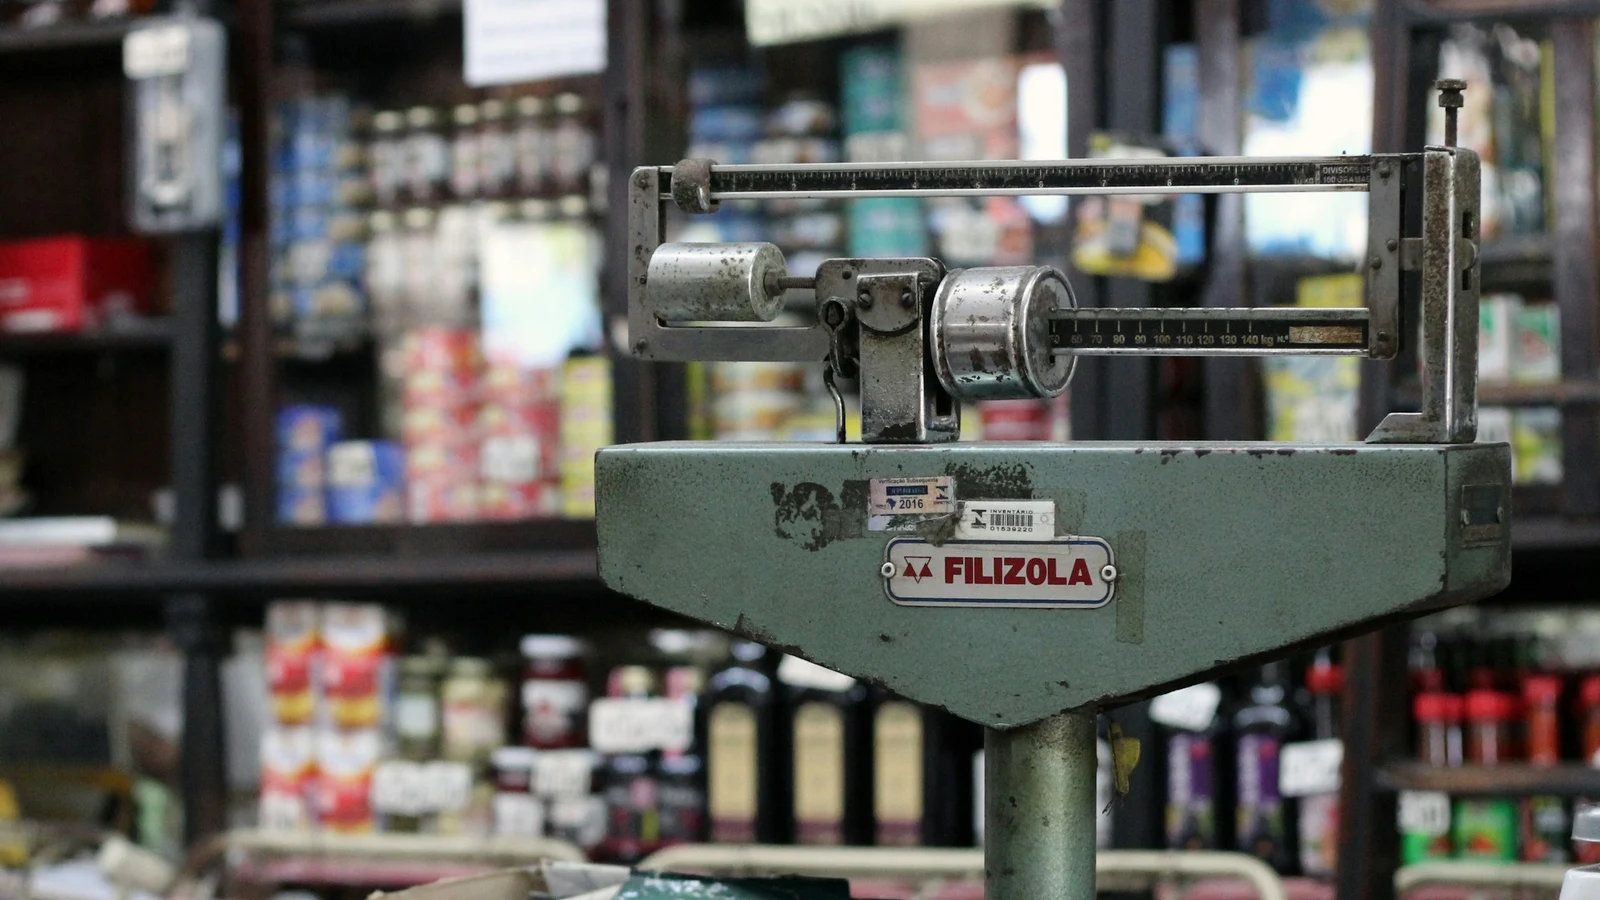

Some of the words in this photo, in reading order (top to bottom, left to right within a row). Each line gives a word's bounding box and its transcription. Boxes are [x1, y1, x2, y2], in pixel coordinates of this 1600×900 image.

[1102, 179, 1107, 187] 7
[1233, 177, 1239, 185] 9
[1070, 334, 1083, 344] 60
[1090, 334, 1103, 344] 70
[1113, 334, 1125, 344] 80
[1135, 334, 1147, 344] 90
[1153, 334, 1171, 344] 100
[1176, 334, 1193, 344] 110
[1197, 334, 1215, 344] 120
[1220, 335, 1237, 345] 130
[1241, 335, 1259, 345] 140
[1261, 335, 1274, 346] kg
[899, 499, 924, 509] 2016
[945, 557, 1093, 585] FILIZOLA
